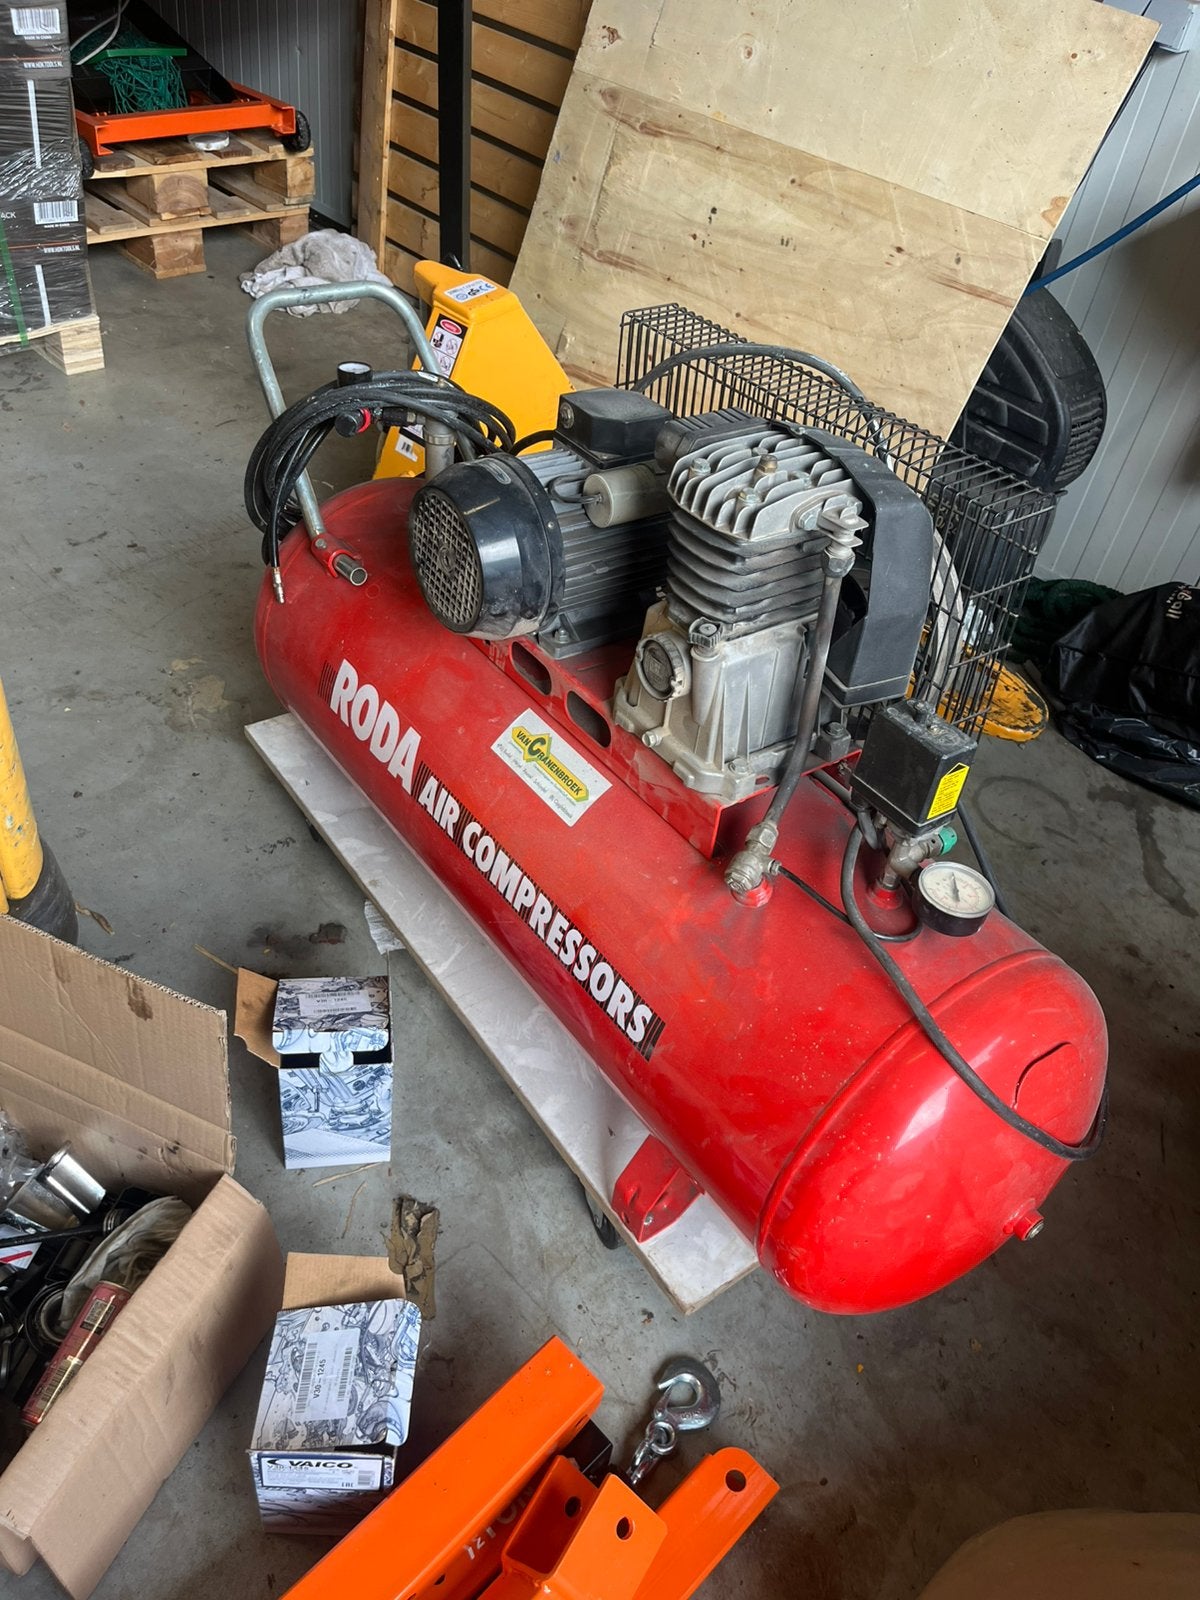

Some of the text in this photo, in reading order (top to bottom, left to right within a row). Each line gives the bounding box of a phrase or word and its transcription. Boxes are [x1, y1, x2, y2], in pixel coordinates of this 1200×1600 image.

[330, 658, 421, 795] RODA
[516, 730, 532, 747] VAN
[527, 737, 583, 796] CRANENBROEK
[417, 775, 460, 839] AIR
[462, 821, 653, 1043] COMPRESSORS
[312, 1384, 321, 1400] V30
[317, 1359, 327, 1376] 1245
[288, 1460, 353, 1469] VAICO
